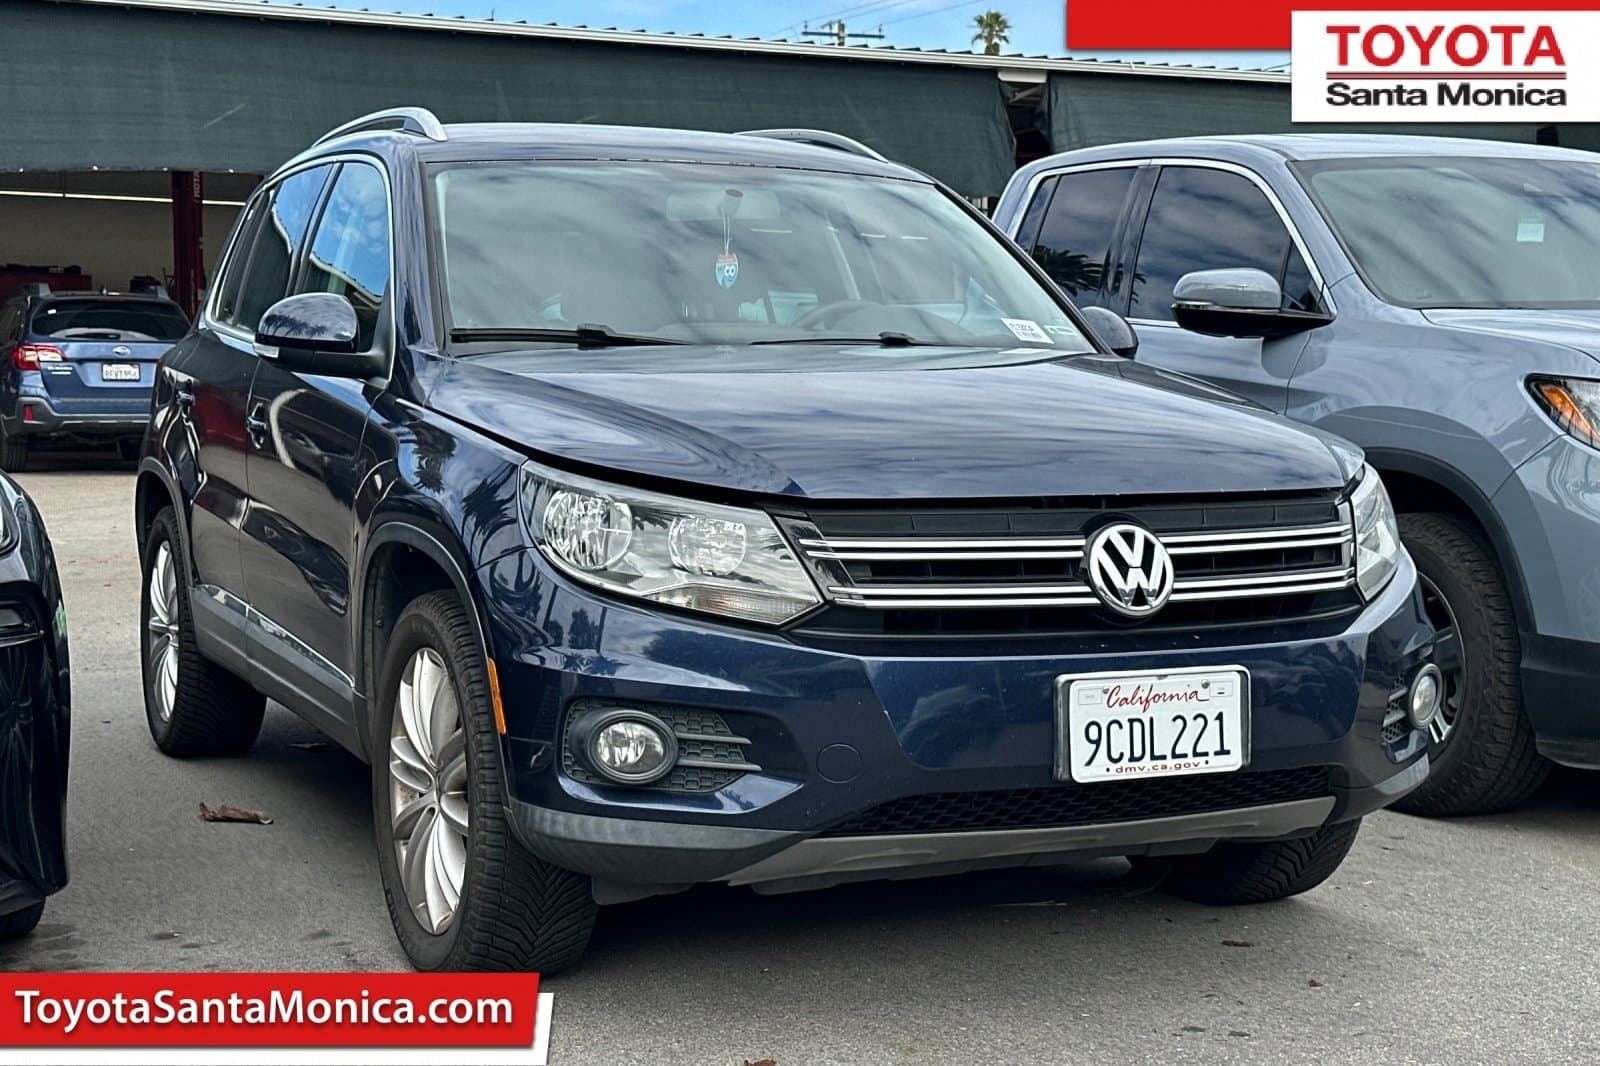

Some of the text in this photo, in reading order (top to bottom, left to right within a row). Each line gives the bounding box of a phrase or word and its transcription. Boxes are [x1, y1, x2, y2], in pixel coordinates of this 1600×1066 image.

[1106, 683, 1209, 713] California
[1084, 711, 1231, 767] 9CDL221
[1115, 761, 1201, 774] dmv.ca.gov
